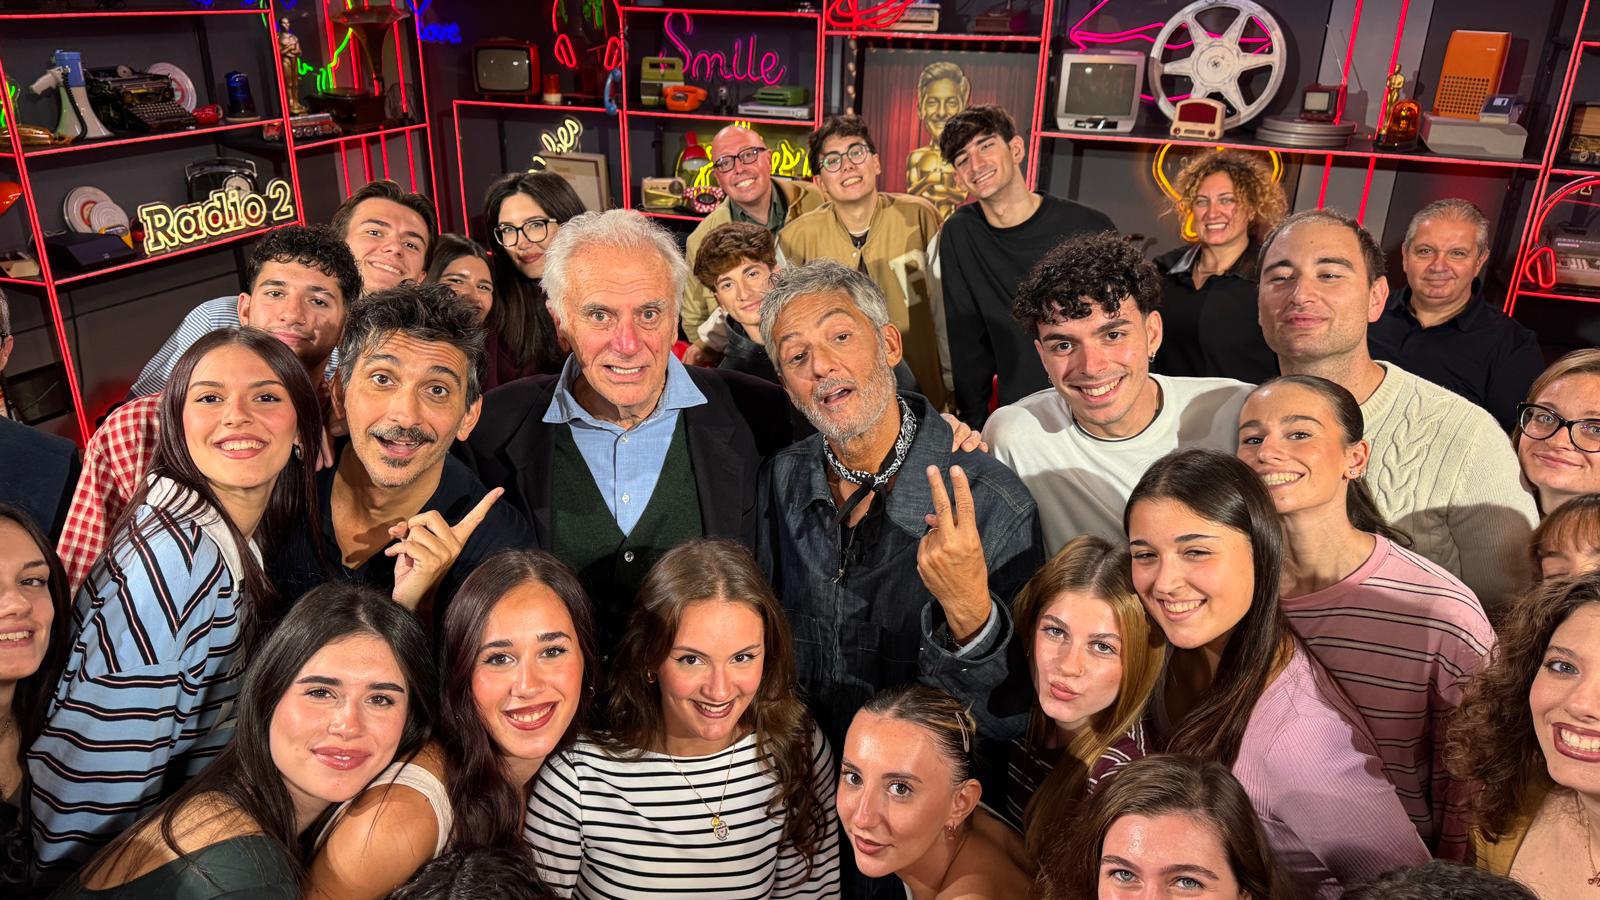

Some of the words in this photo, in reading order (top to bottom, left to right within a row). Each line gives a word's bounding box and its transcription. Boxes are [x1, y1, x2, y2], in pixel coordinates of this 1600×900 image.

[659, 12, 785, 85] Smile
[140, 188, 267, 253] Radio
[269, 179, 294, 221] 2
